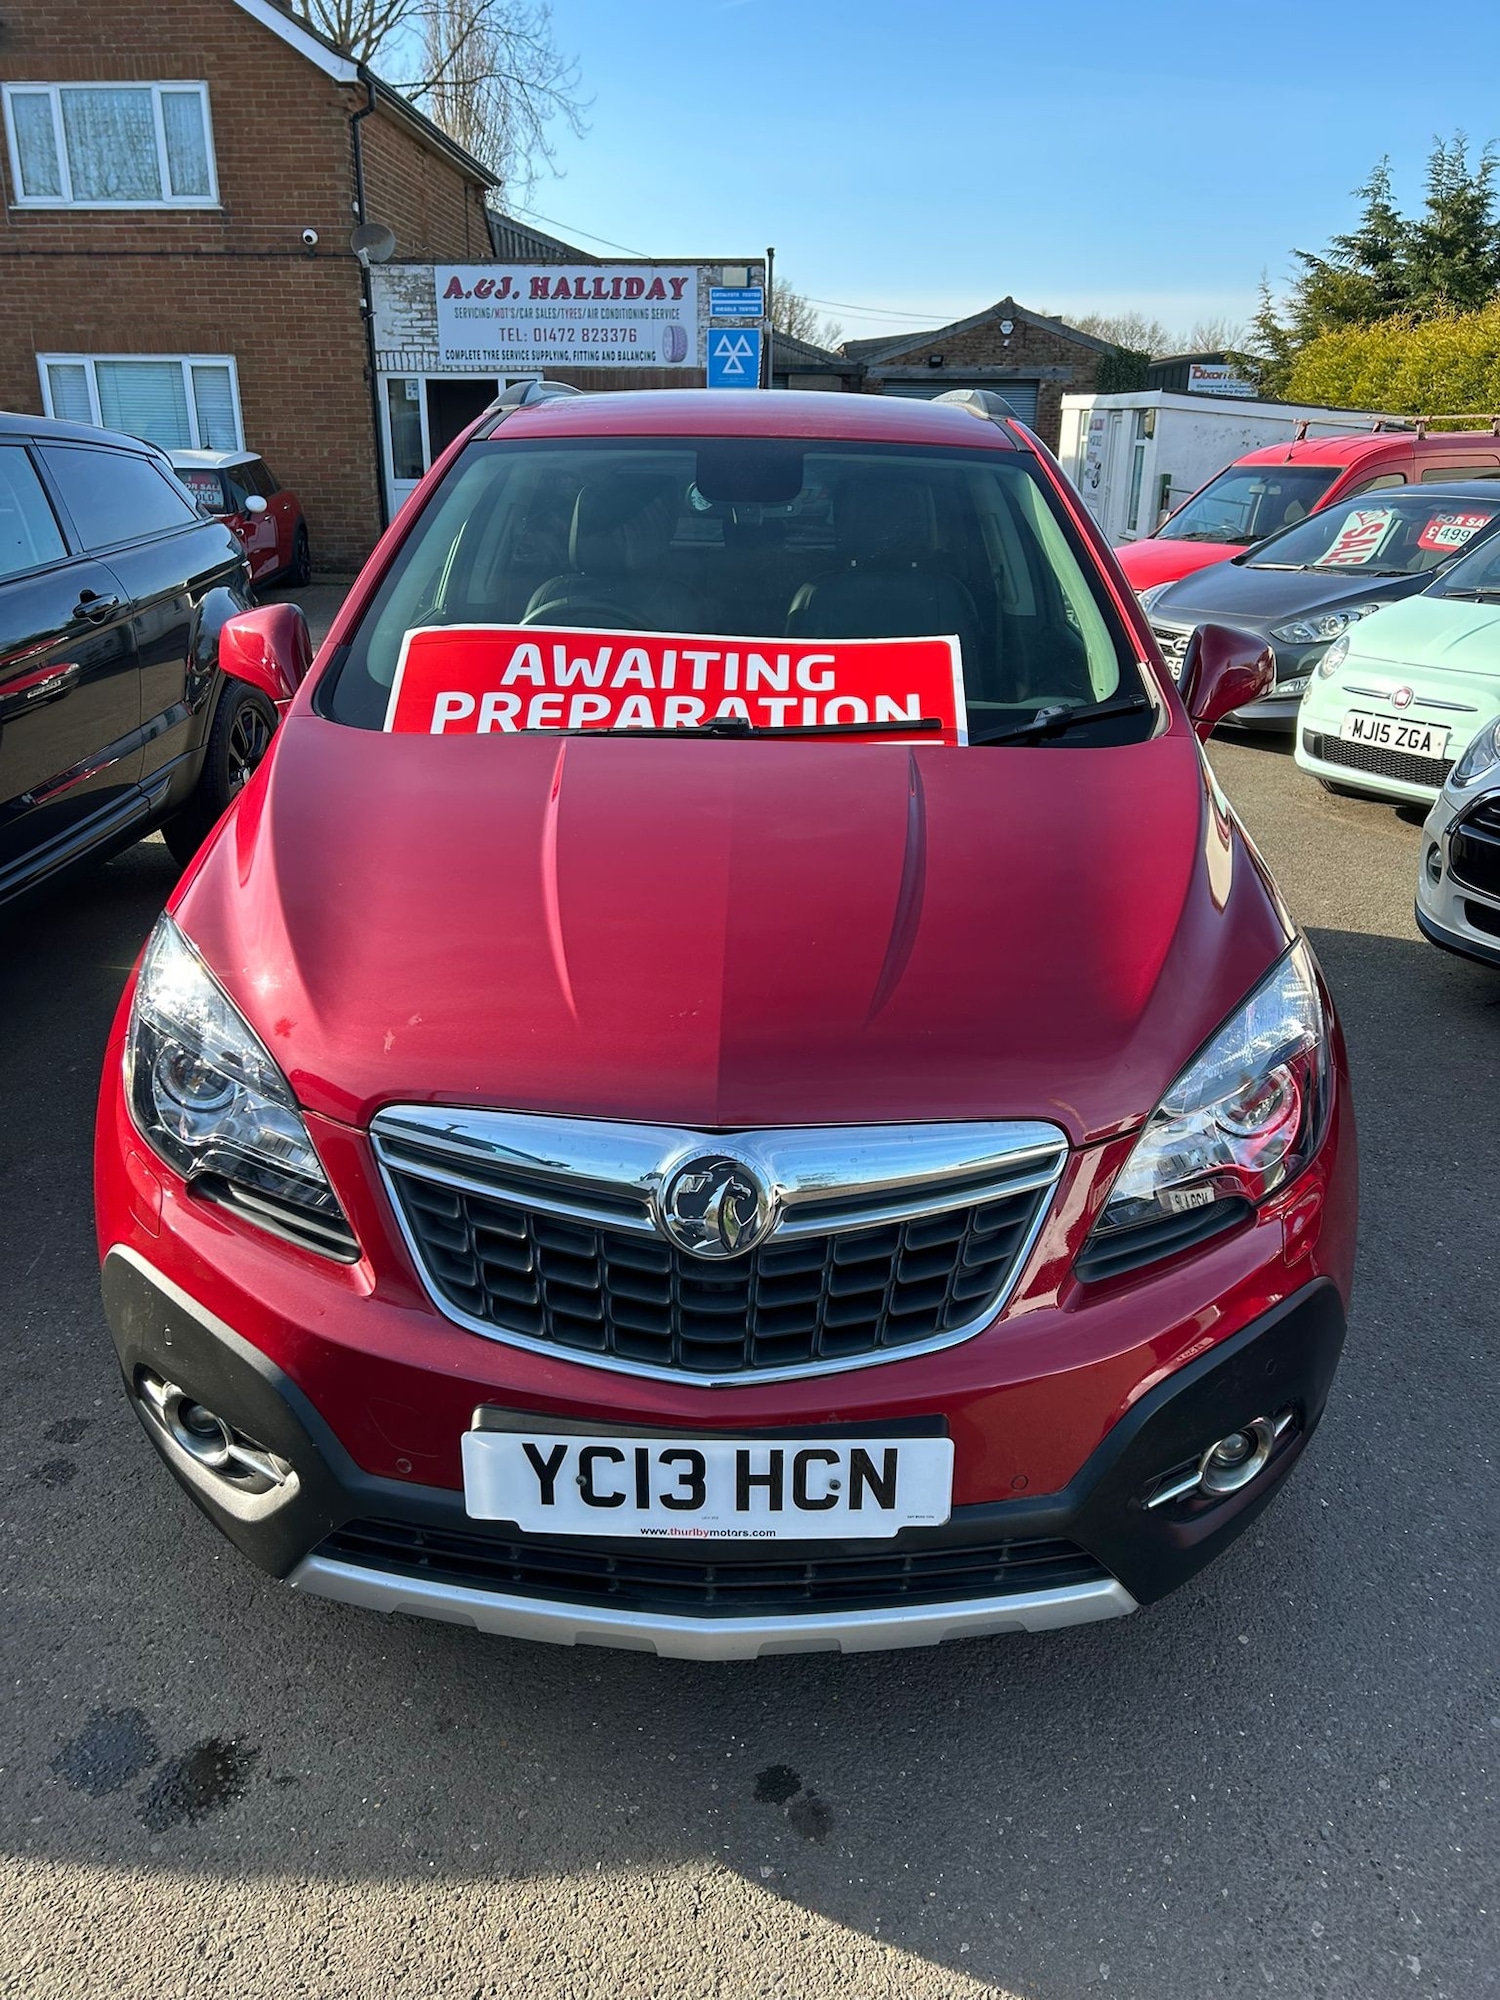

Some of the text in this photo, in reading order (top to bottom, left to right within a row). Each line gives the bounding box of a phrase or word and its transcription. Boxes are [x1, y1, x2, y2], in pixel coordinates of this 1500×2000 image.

[528, 276, 689, 300] HALLIDAY
[600, 307, 649, 320] CONDITIONING
[651, 308, 680, 320] SERVICE
[499, 327, 637, 343] TEL: 01472 823376
[445, 349, 657, 362] COMPLETE TYRE SERVICE SUPPLYING, FITTING AND BALANCING
[1435, 513, 1465, 525] FOR
[1320, 522, 1385, 565] SALE
[500, 642, 836, 692] AWAITING
[429, 691, 921, 735] PREPARATION
[1351, 718, 1431, 752] MJ15 ZGA
[521, 1442, 898, 1512] YC13 HCN
[640, 1527, 776, 1538] www.thurlbymotors.com
